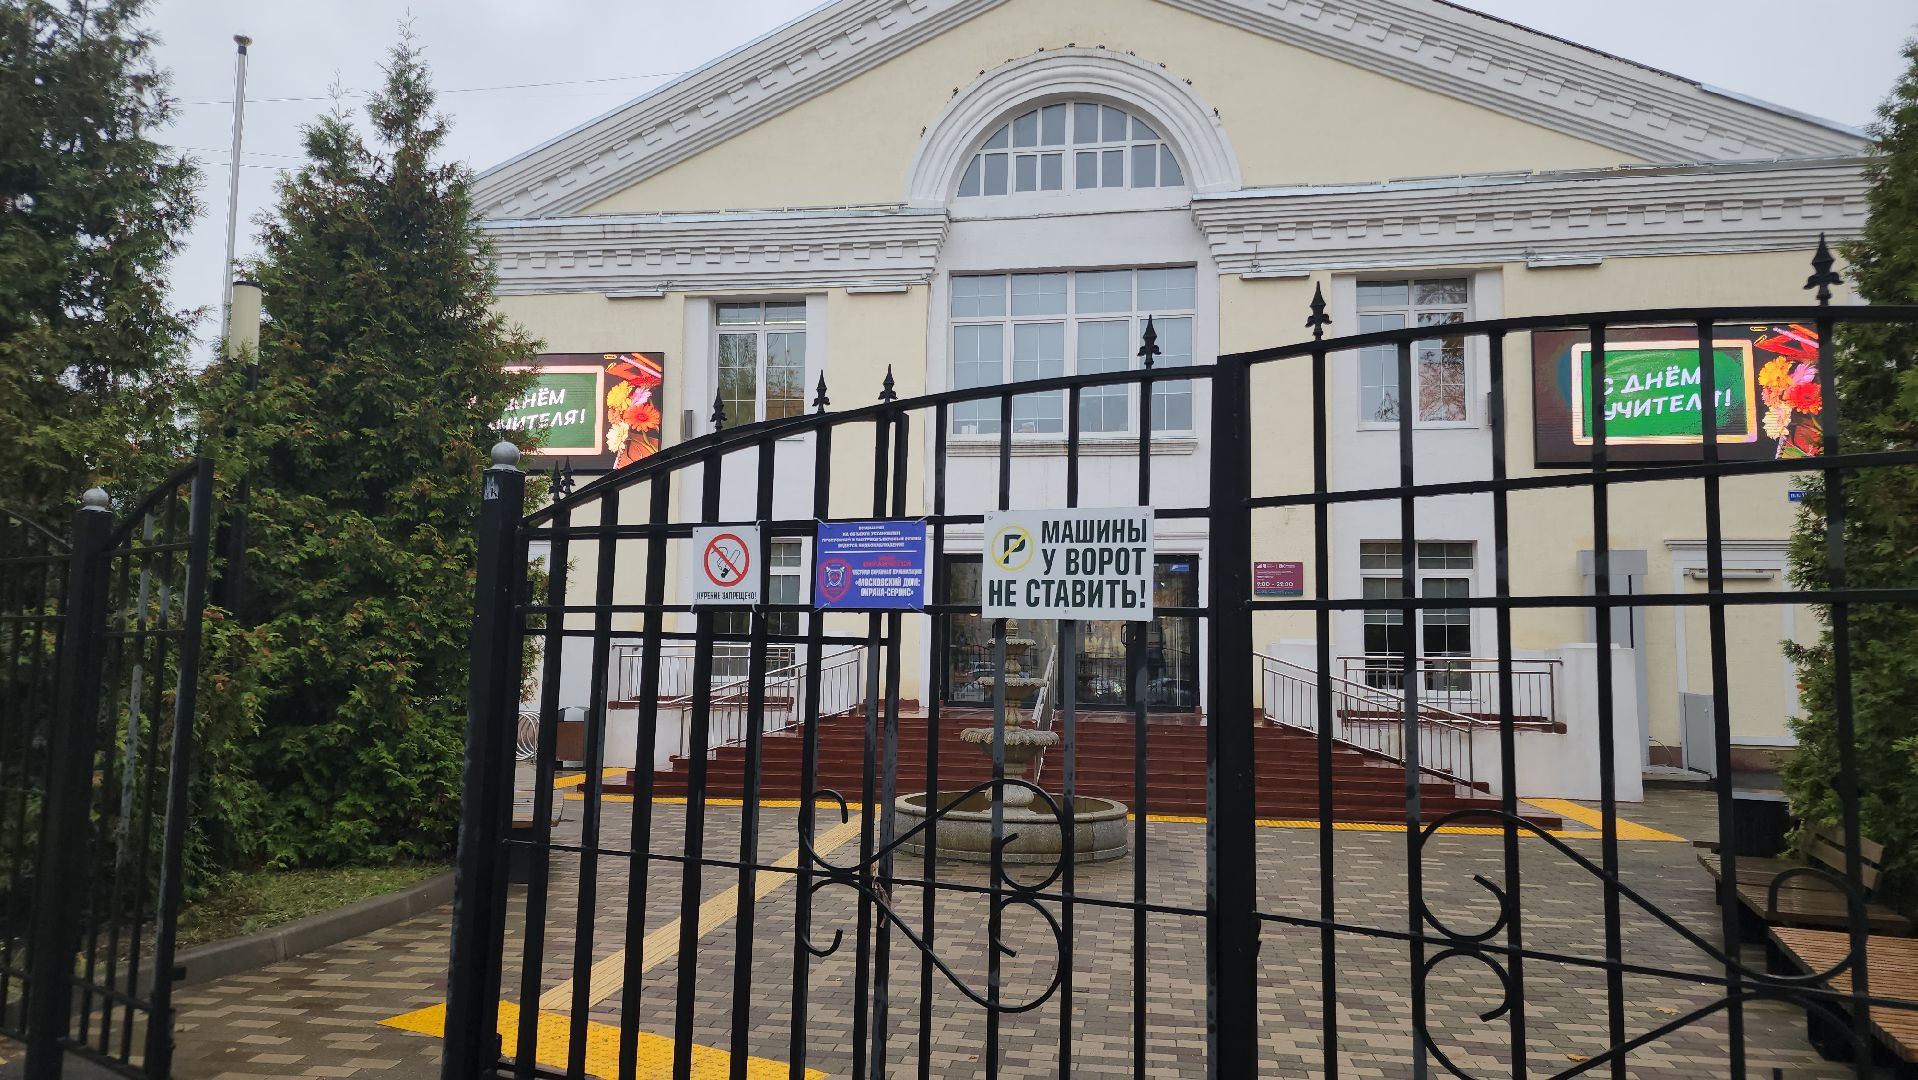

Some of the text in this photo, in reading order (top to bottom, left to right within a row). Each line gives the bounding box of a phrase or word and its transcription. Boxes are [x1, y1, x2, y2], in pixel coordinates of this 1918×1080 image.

[1620, 365, 1701, 394] ДНЁМ
[1041, 518, 1147, 544] МАШИНЫ
[1041, 547, 1147, 576] У ВОРОТ
[696, 591, 757, 602] КУРЕНИЕ ЗАПРЕЩЕНО!
[988, 578, 1146, 609] НЕ СТАВИТЬ!
